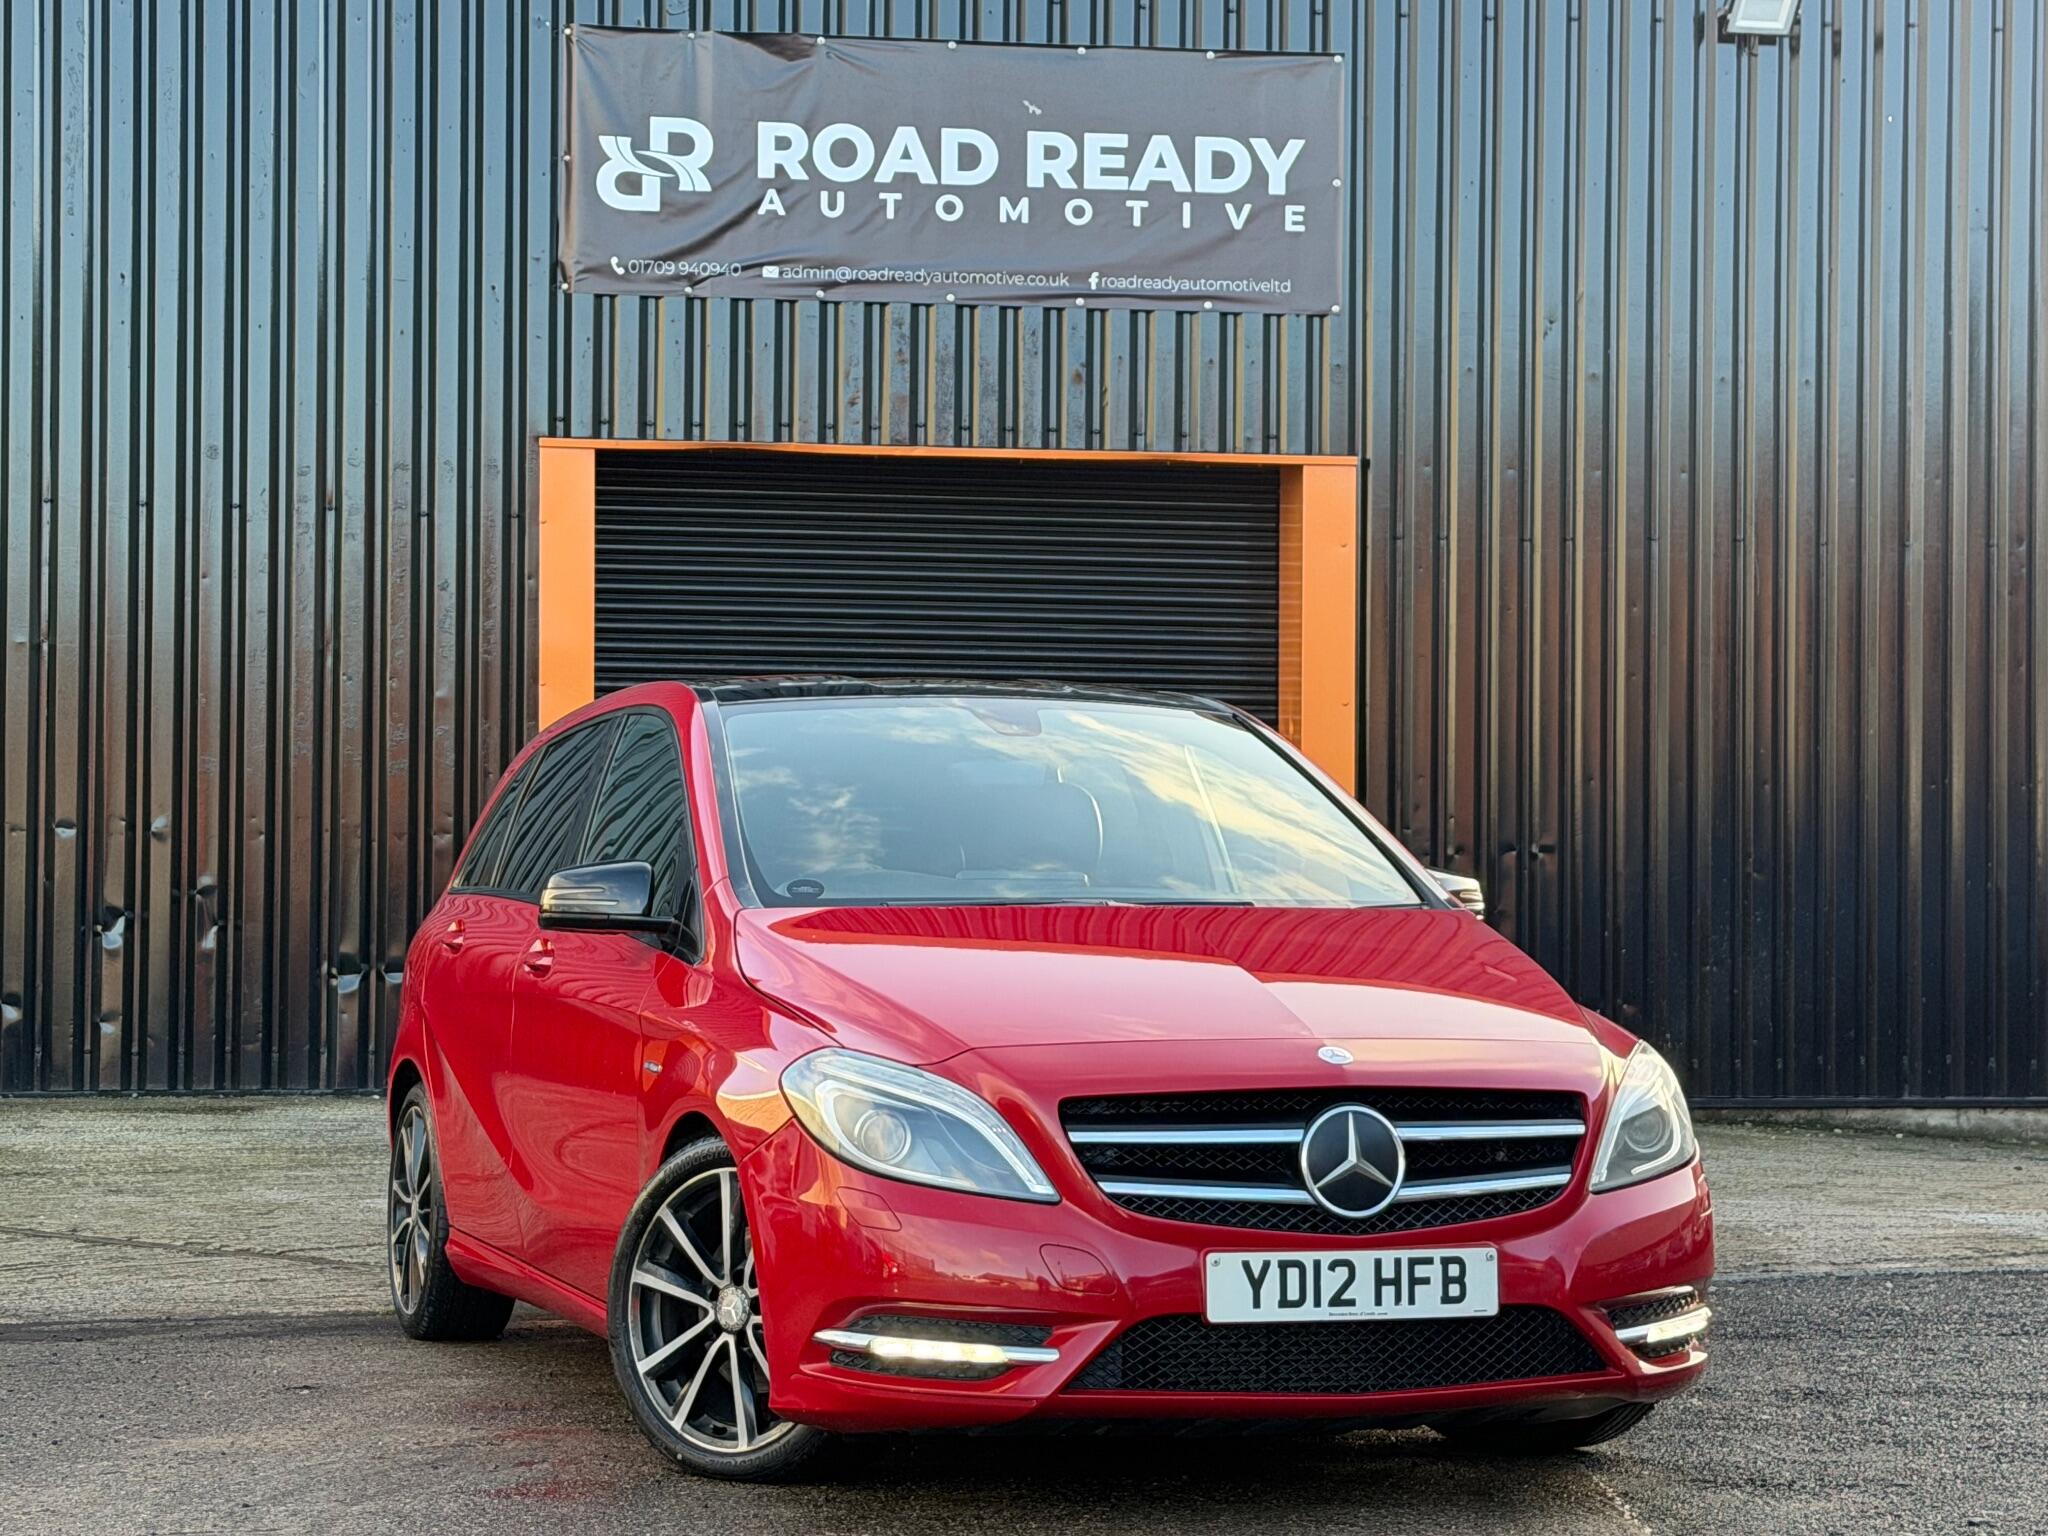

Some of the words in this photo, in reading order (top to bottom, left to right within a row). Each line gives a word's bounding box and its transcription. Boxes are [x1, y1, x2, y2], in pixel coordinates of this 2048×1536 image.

[757, 121, 999, 186] ROAD
[1027, 130, 1306, 196] READY
[757, 188, 1306, 232] AUTOMOTIVE
[628, 260, 675, 275] 01709
[679, 262, 742, 277] 940940
[782, 265, 1070, 287] admin@roadreadyautomotive.co.uk
[1101, 274, 1292, 293] roadreadyautomotiveltd
[664, 1145, 731, 1185] BRIDGESTO
[1241, 1258, 1357, 1309] YD12
[1374, 1256, 1467, 1307] HFB
